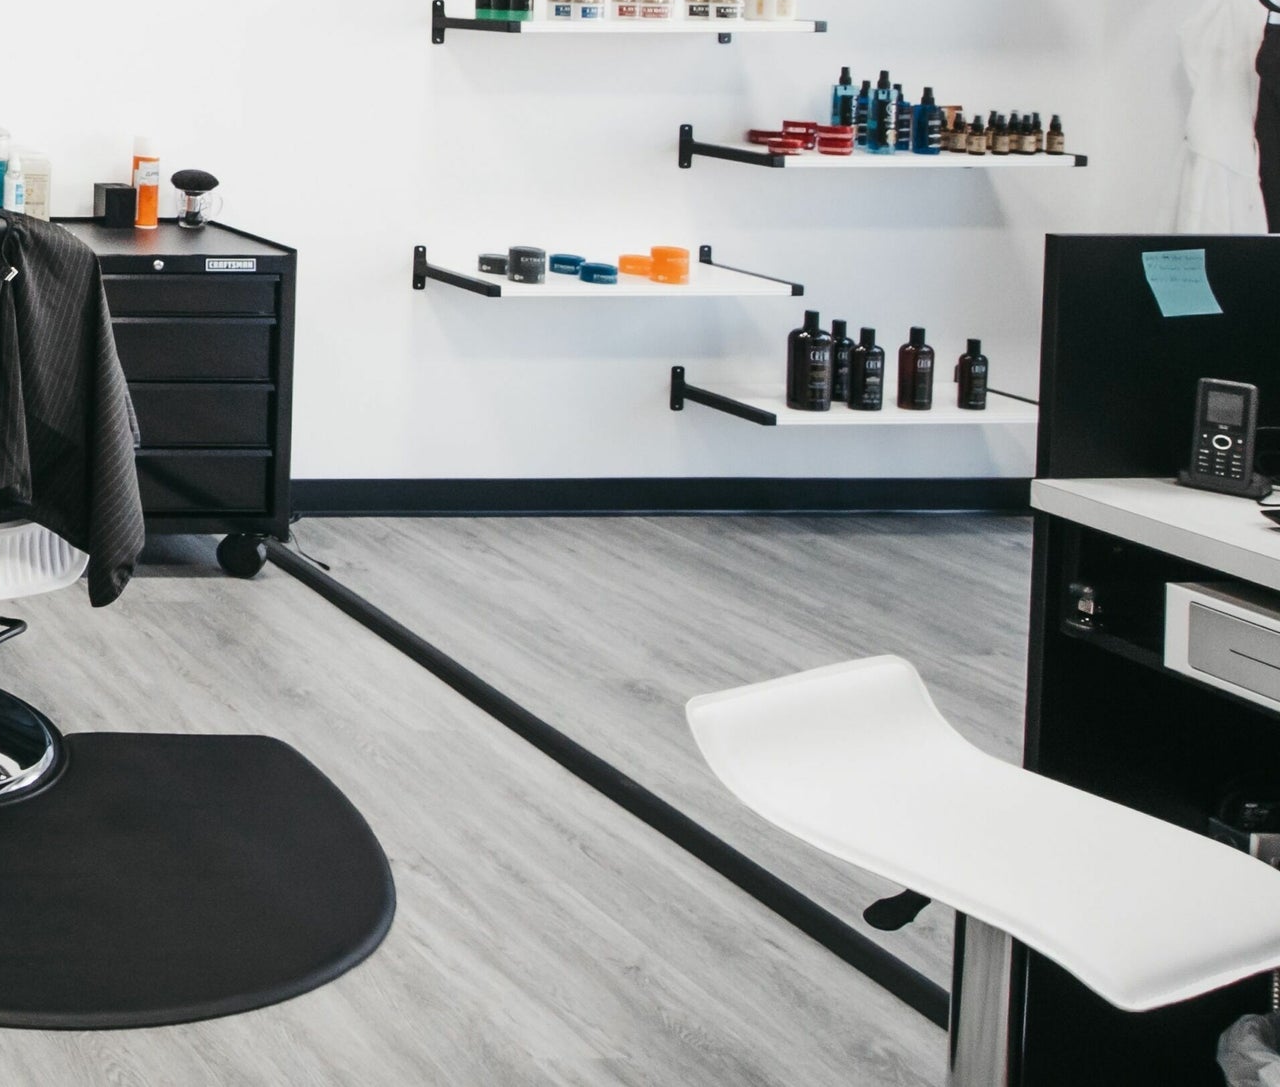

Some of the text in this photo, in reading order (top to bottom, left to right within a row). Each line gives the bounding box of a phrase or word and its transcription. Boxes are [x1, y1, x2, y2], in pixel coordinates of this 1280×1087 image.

[810, 351, 831, 362] CREW
[837, 351, 849, 361] CRE
[865, 360, 882, 369] CREW
